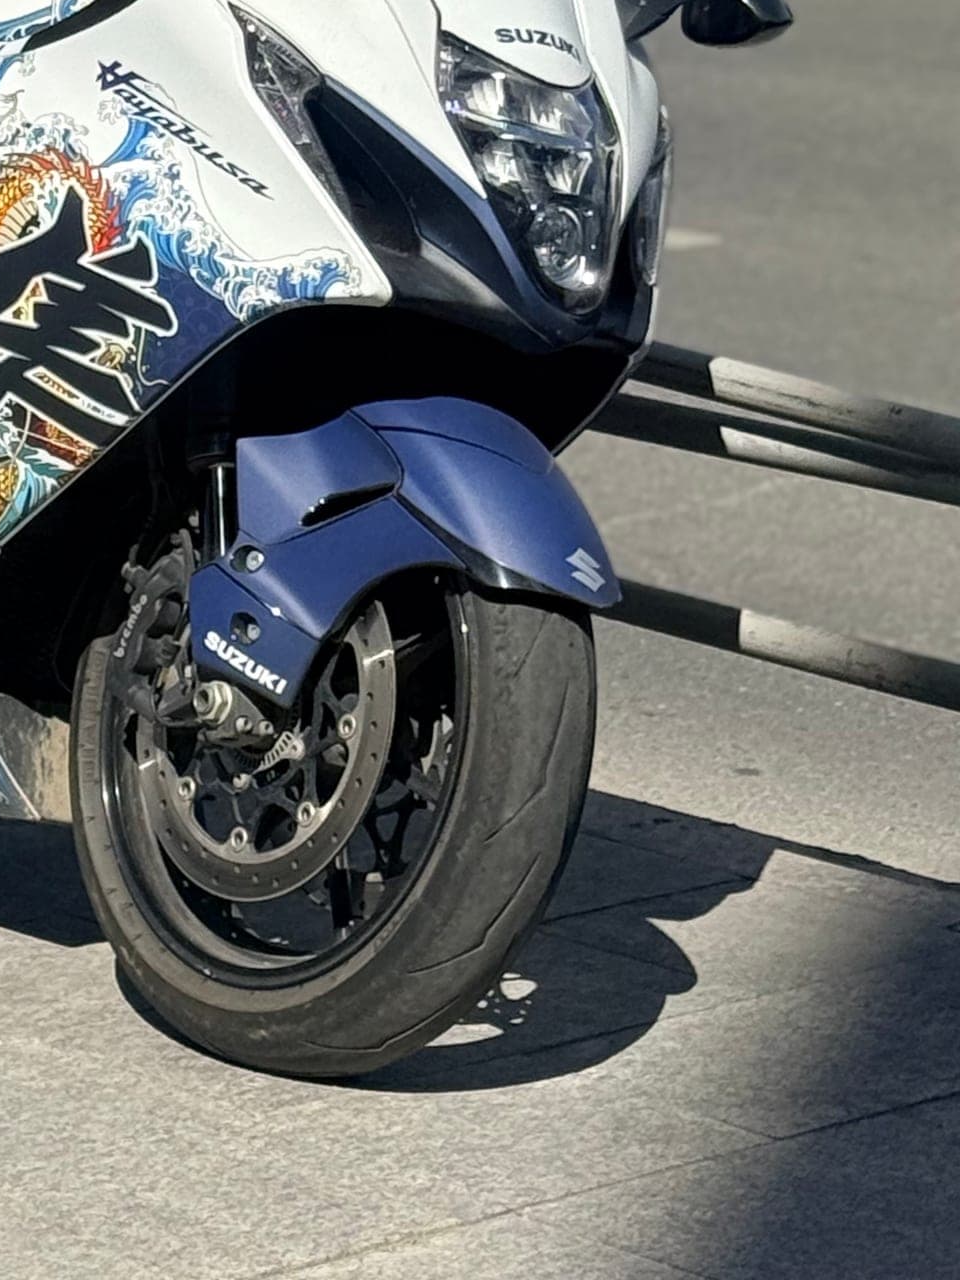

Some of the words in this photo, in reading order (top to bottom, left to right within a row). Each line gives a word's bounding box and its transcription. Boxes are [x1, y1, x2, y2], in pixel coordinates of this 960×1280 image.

[494, 27, 582, 65] SUZUKI
[113, 594, 147, 658] brembo
[203, 630, 288, 695] SUZUKI
